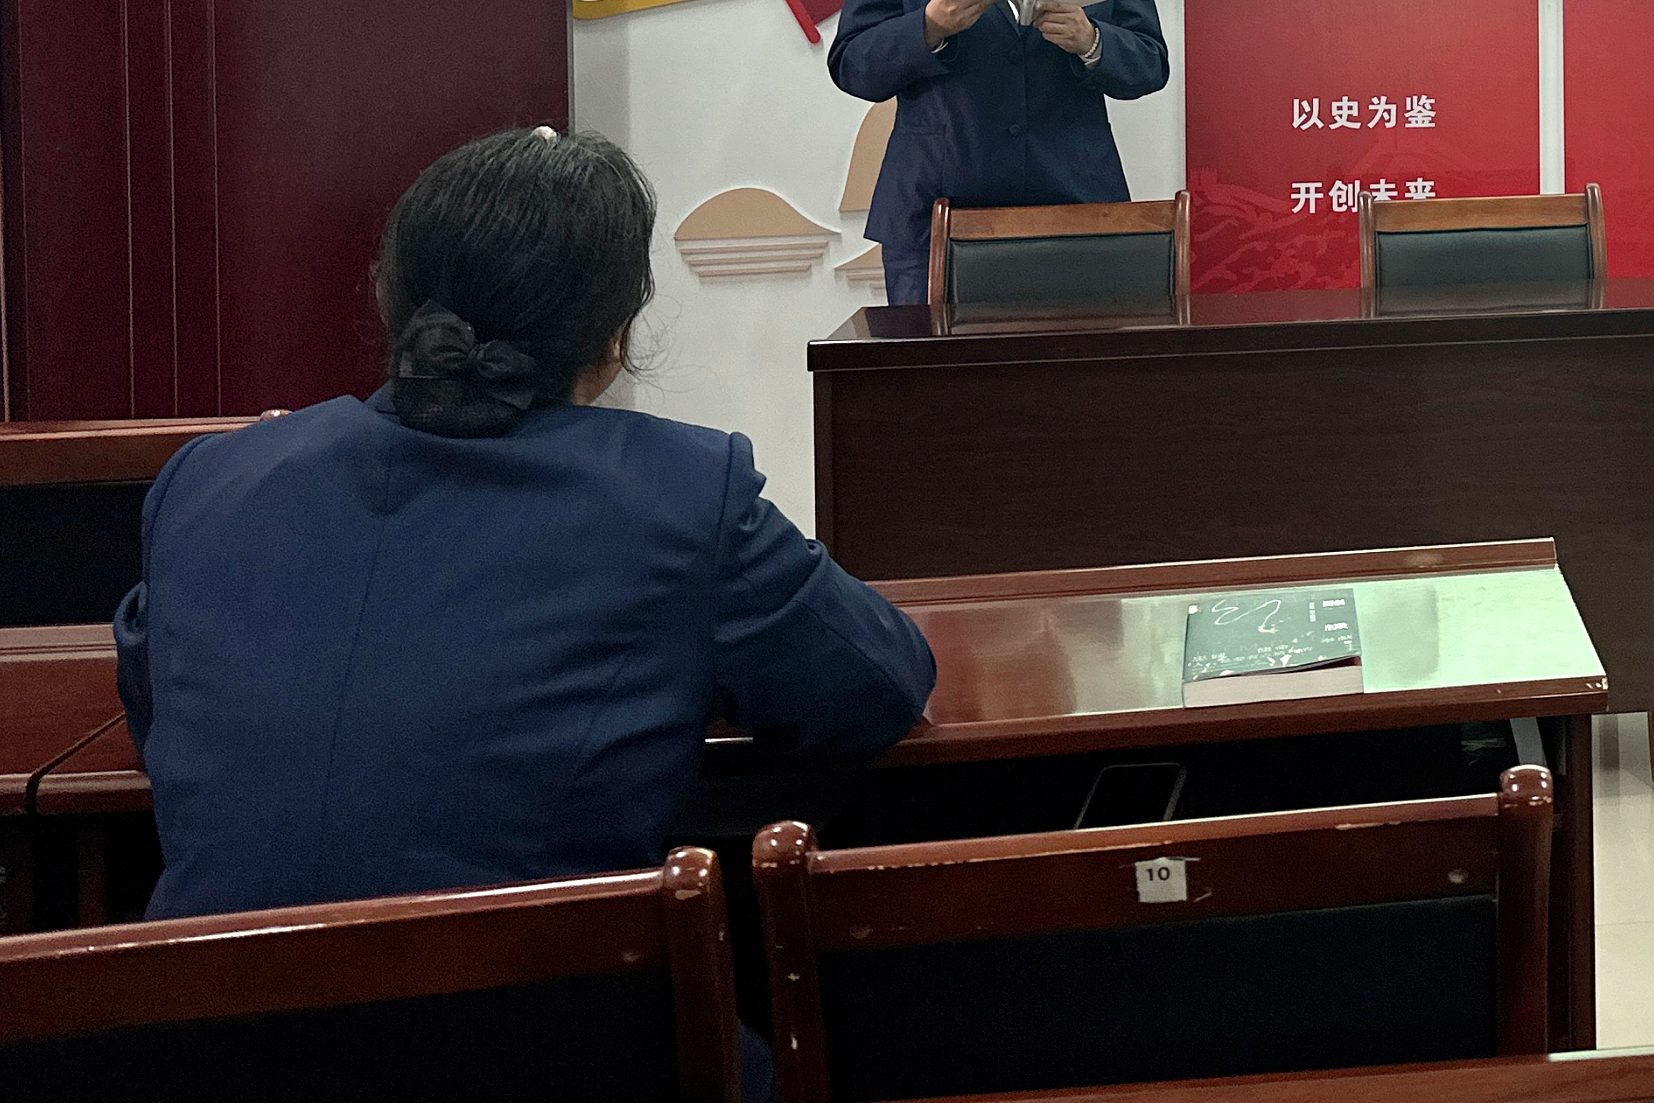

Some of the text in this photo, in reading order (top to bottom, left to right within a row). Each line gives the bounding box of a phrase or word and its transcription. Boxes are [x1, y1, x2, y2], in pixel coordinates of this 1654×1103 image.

[1291, 95, 1436, 130] 以史为鉴
[1146, 866, 1170, 881] 10
